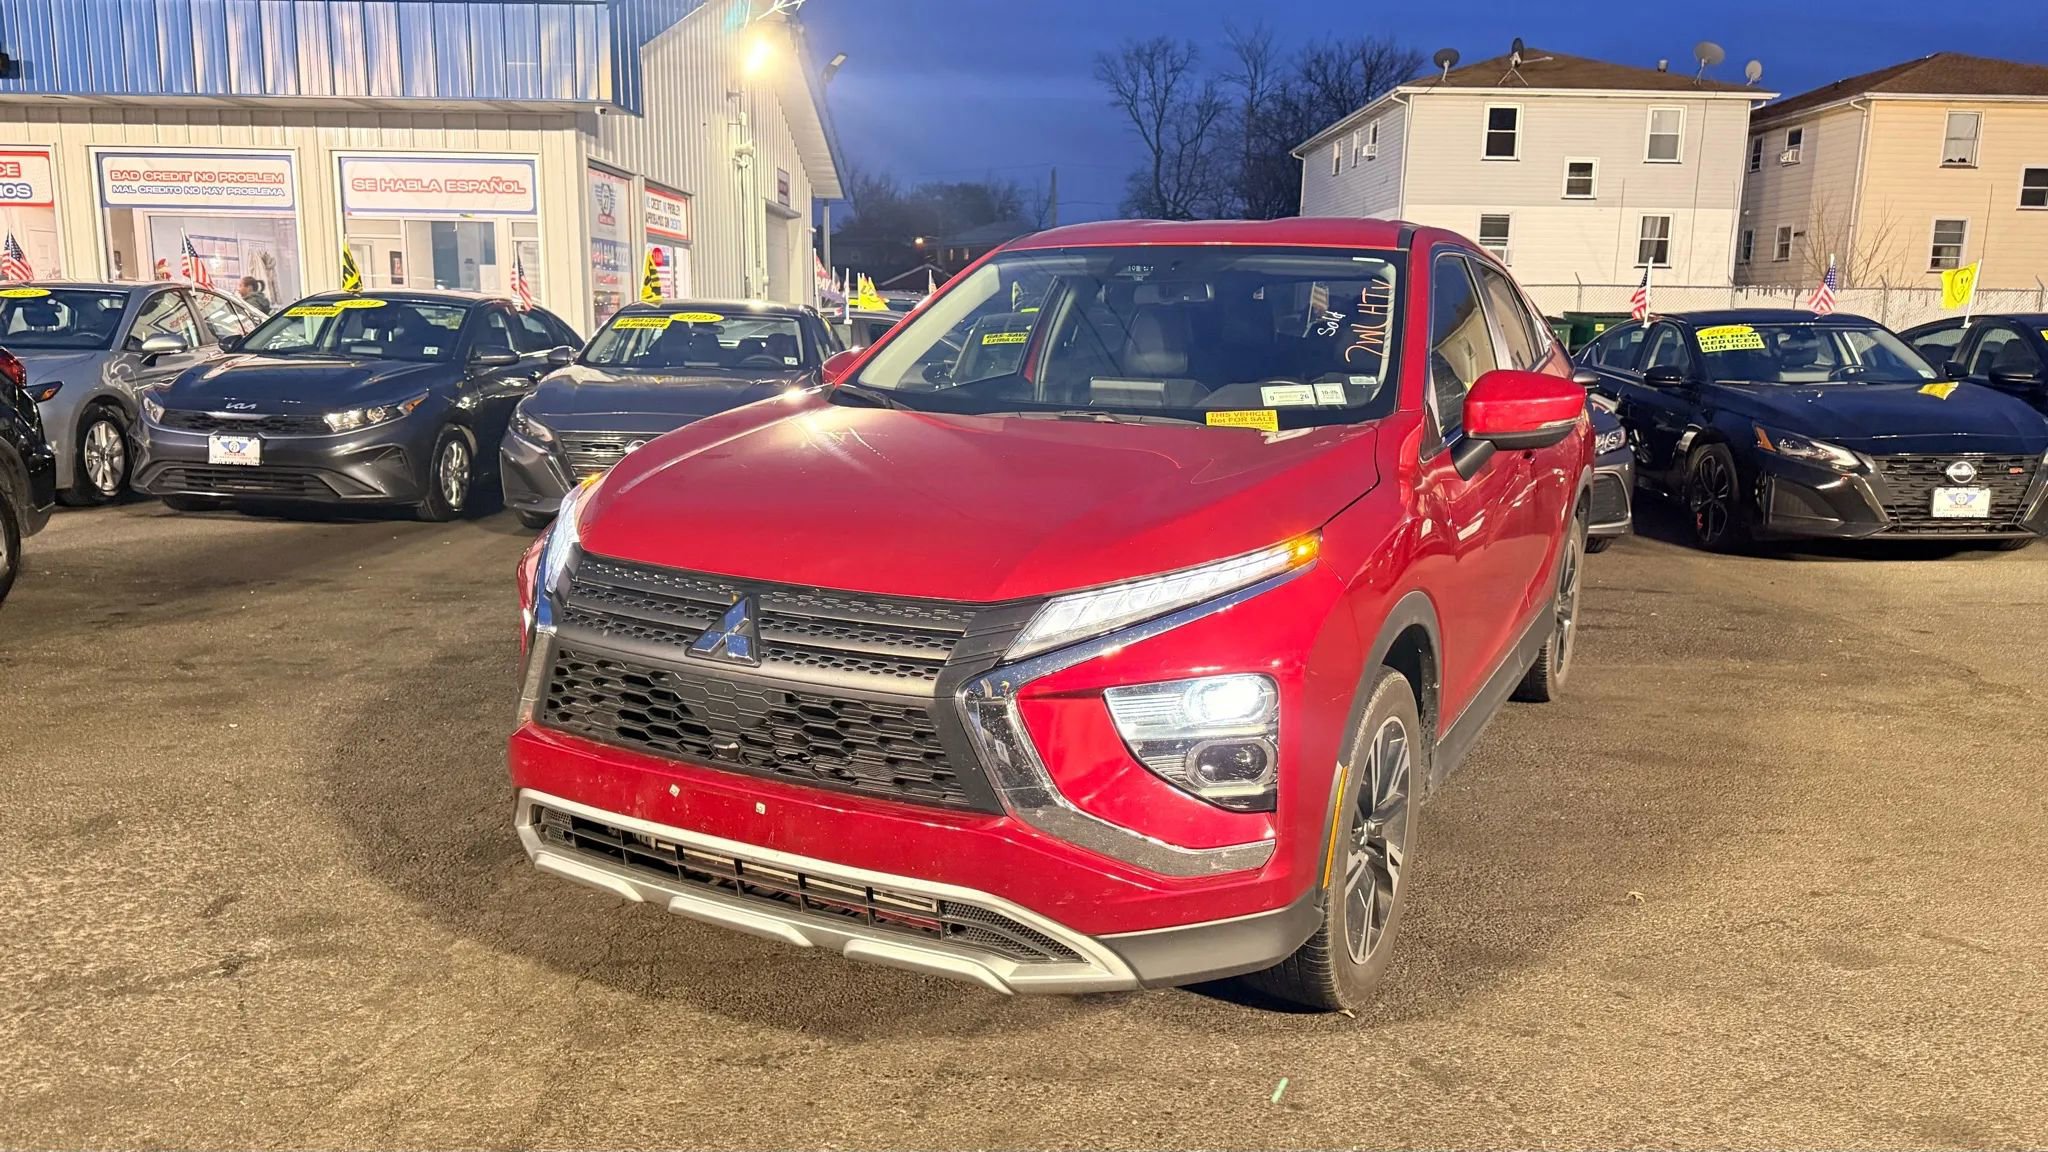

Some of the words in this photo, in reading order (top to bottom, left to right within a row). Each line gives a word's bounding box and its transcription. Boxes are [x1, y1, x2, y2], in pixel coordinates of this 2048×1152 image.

[110, 170, 141, 181] BAD
[143, 171, 192, 182] CREDIT
[194, 171, 216, 183] NO
[217, 172, 285, 184] PROBLEM
[112, 185, 137, 193] MAL
[138, 185, 182, 194] CREDITO
[183, 186, 200, 194] NO
[202, 186, 225, 195] HAY
[226, 187, 285, 196] PROBLEMA
[352, 178, 377, 191] SE
[380, 178, 442, 192] HABLA
[445, 177, 526, 193] ESPAÑOL
[1701, 338, 1759, 346] REDUCED
